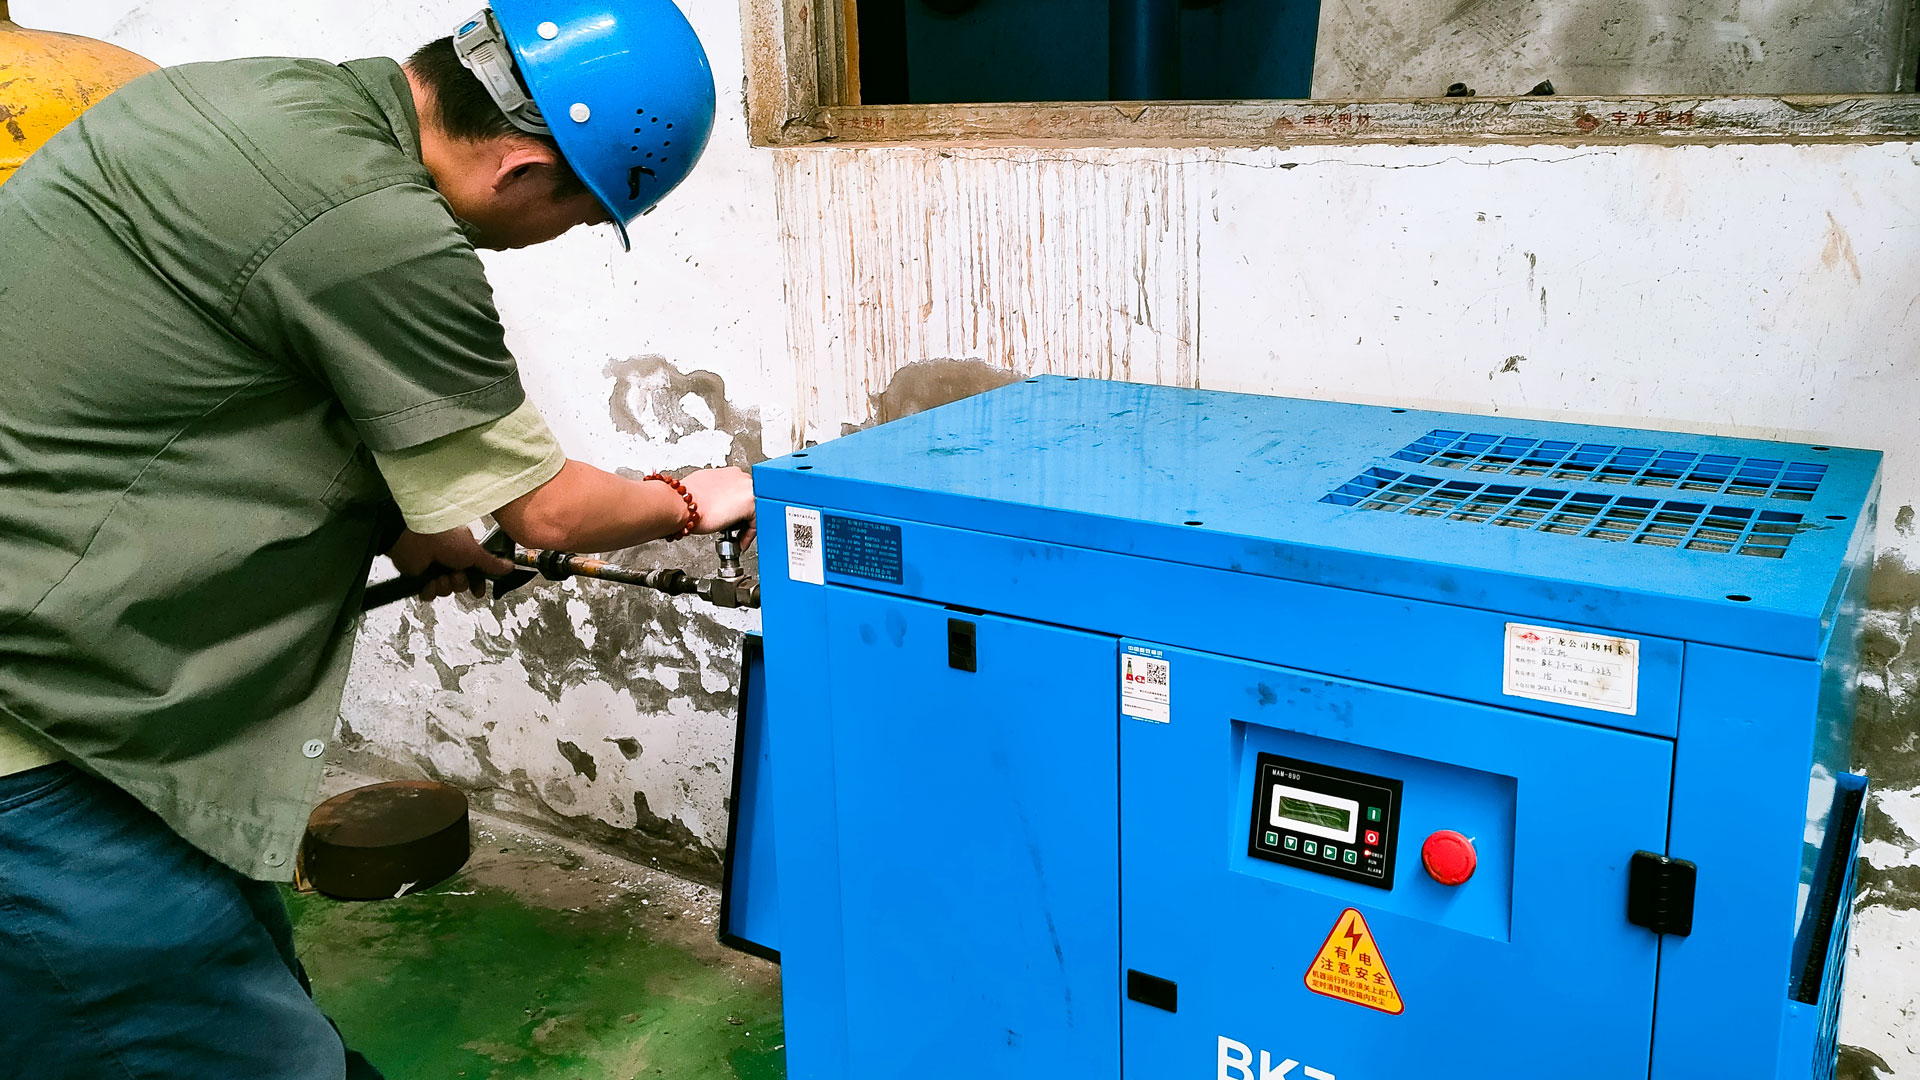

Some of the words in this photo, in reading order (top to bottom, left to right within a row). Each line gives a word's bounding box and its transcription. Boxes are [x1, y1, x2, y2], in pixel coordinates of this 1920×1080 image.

[1303, 113, 1372, 127] 宇龙型材
[1612, 111, 1694, 127] 宇龙型材
[1272, 769, 1301, 781] MAM-890
[1369, 851, 1383, 859] POWER
[1320, 956, 1387, 986] 注意安全
[1311, 979, 1386, 1006] 定时清理电控箱内灰尘
[1217, 1035, 1336, 1080] BK
